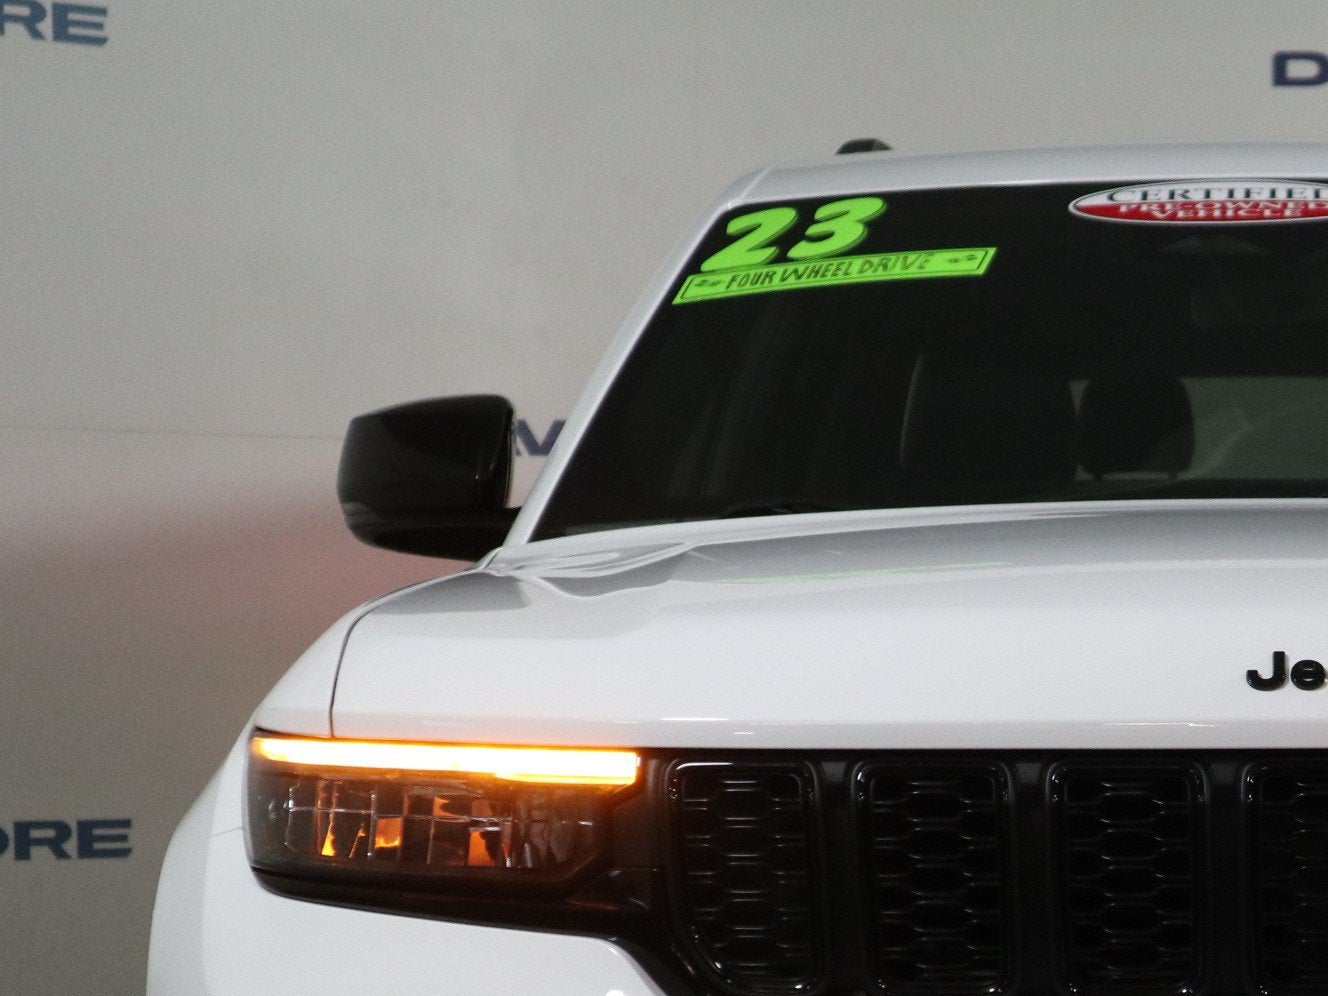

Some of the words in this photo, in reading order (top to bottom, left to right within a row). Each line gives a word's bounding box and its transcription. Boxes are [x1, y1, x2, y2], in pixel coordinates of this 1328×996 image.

[700, 196, 888, 272] 23
[1151, 208, 1303, 220] VEHICLE
[725, 269, 778, 291] FOUR
[779, 258, 854, 283] WHEEL
[857, 250, 935, 275] DRIVE
[0, 818, 132, 861] RE
